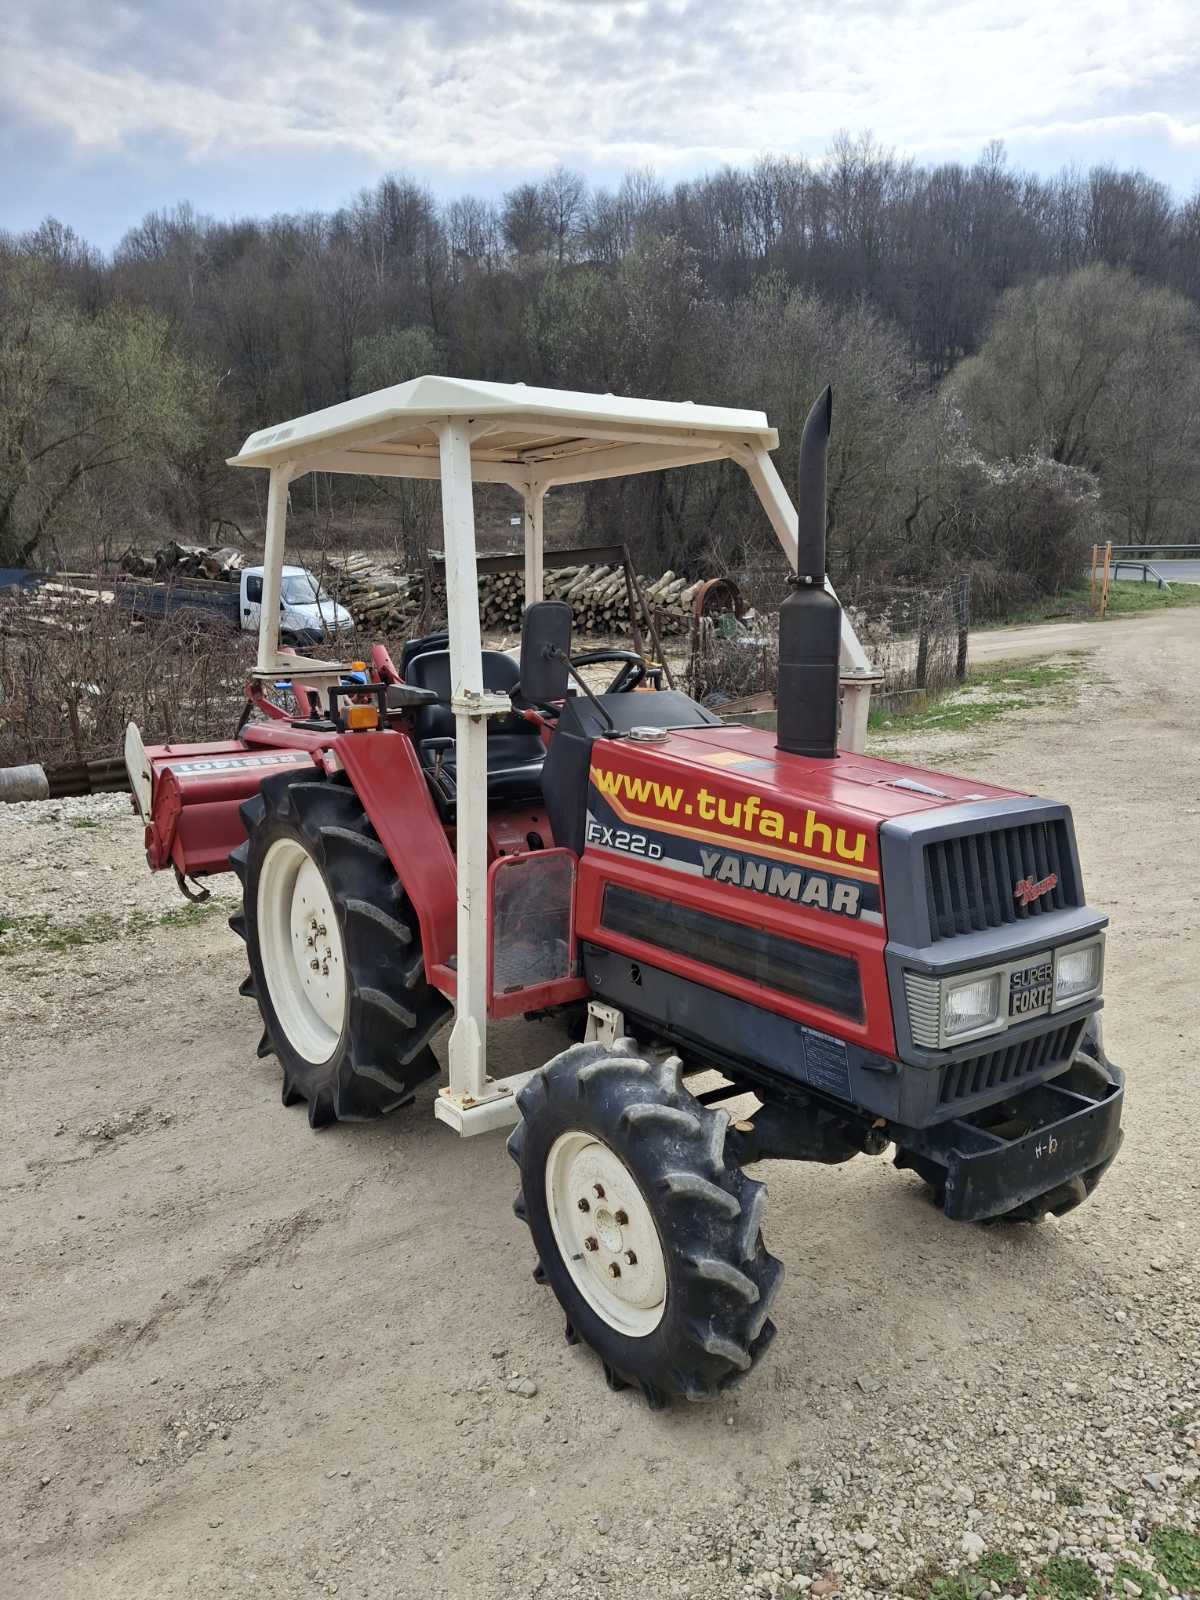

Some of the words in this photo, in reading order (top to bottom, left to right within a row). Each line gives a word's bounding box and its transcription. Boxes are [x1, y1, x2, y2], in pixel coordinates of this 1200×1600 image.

[595, 768, 867, 862] www.tufa.hu
[588, 823, 662, 859] FX22D
[700, 850, 861, 915] YANMAR
[1012, 963, 1053, 989] SUPER
[1012, 983, 1053, 1016] FORTE
